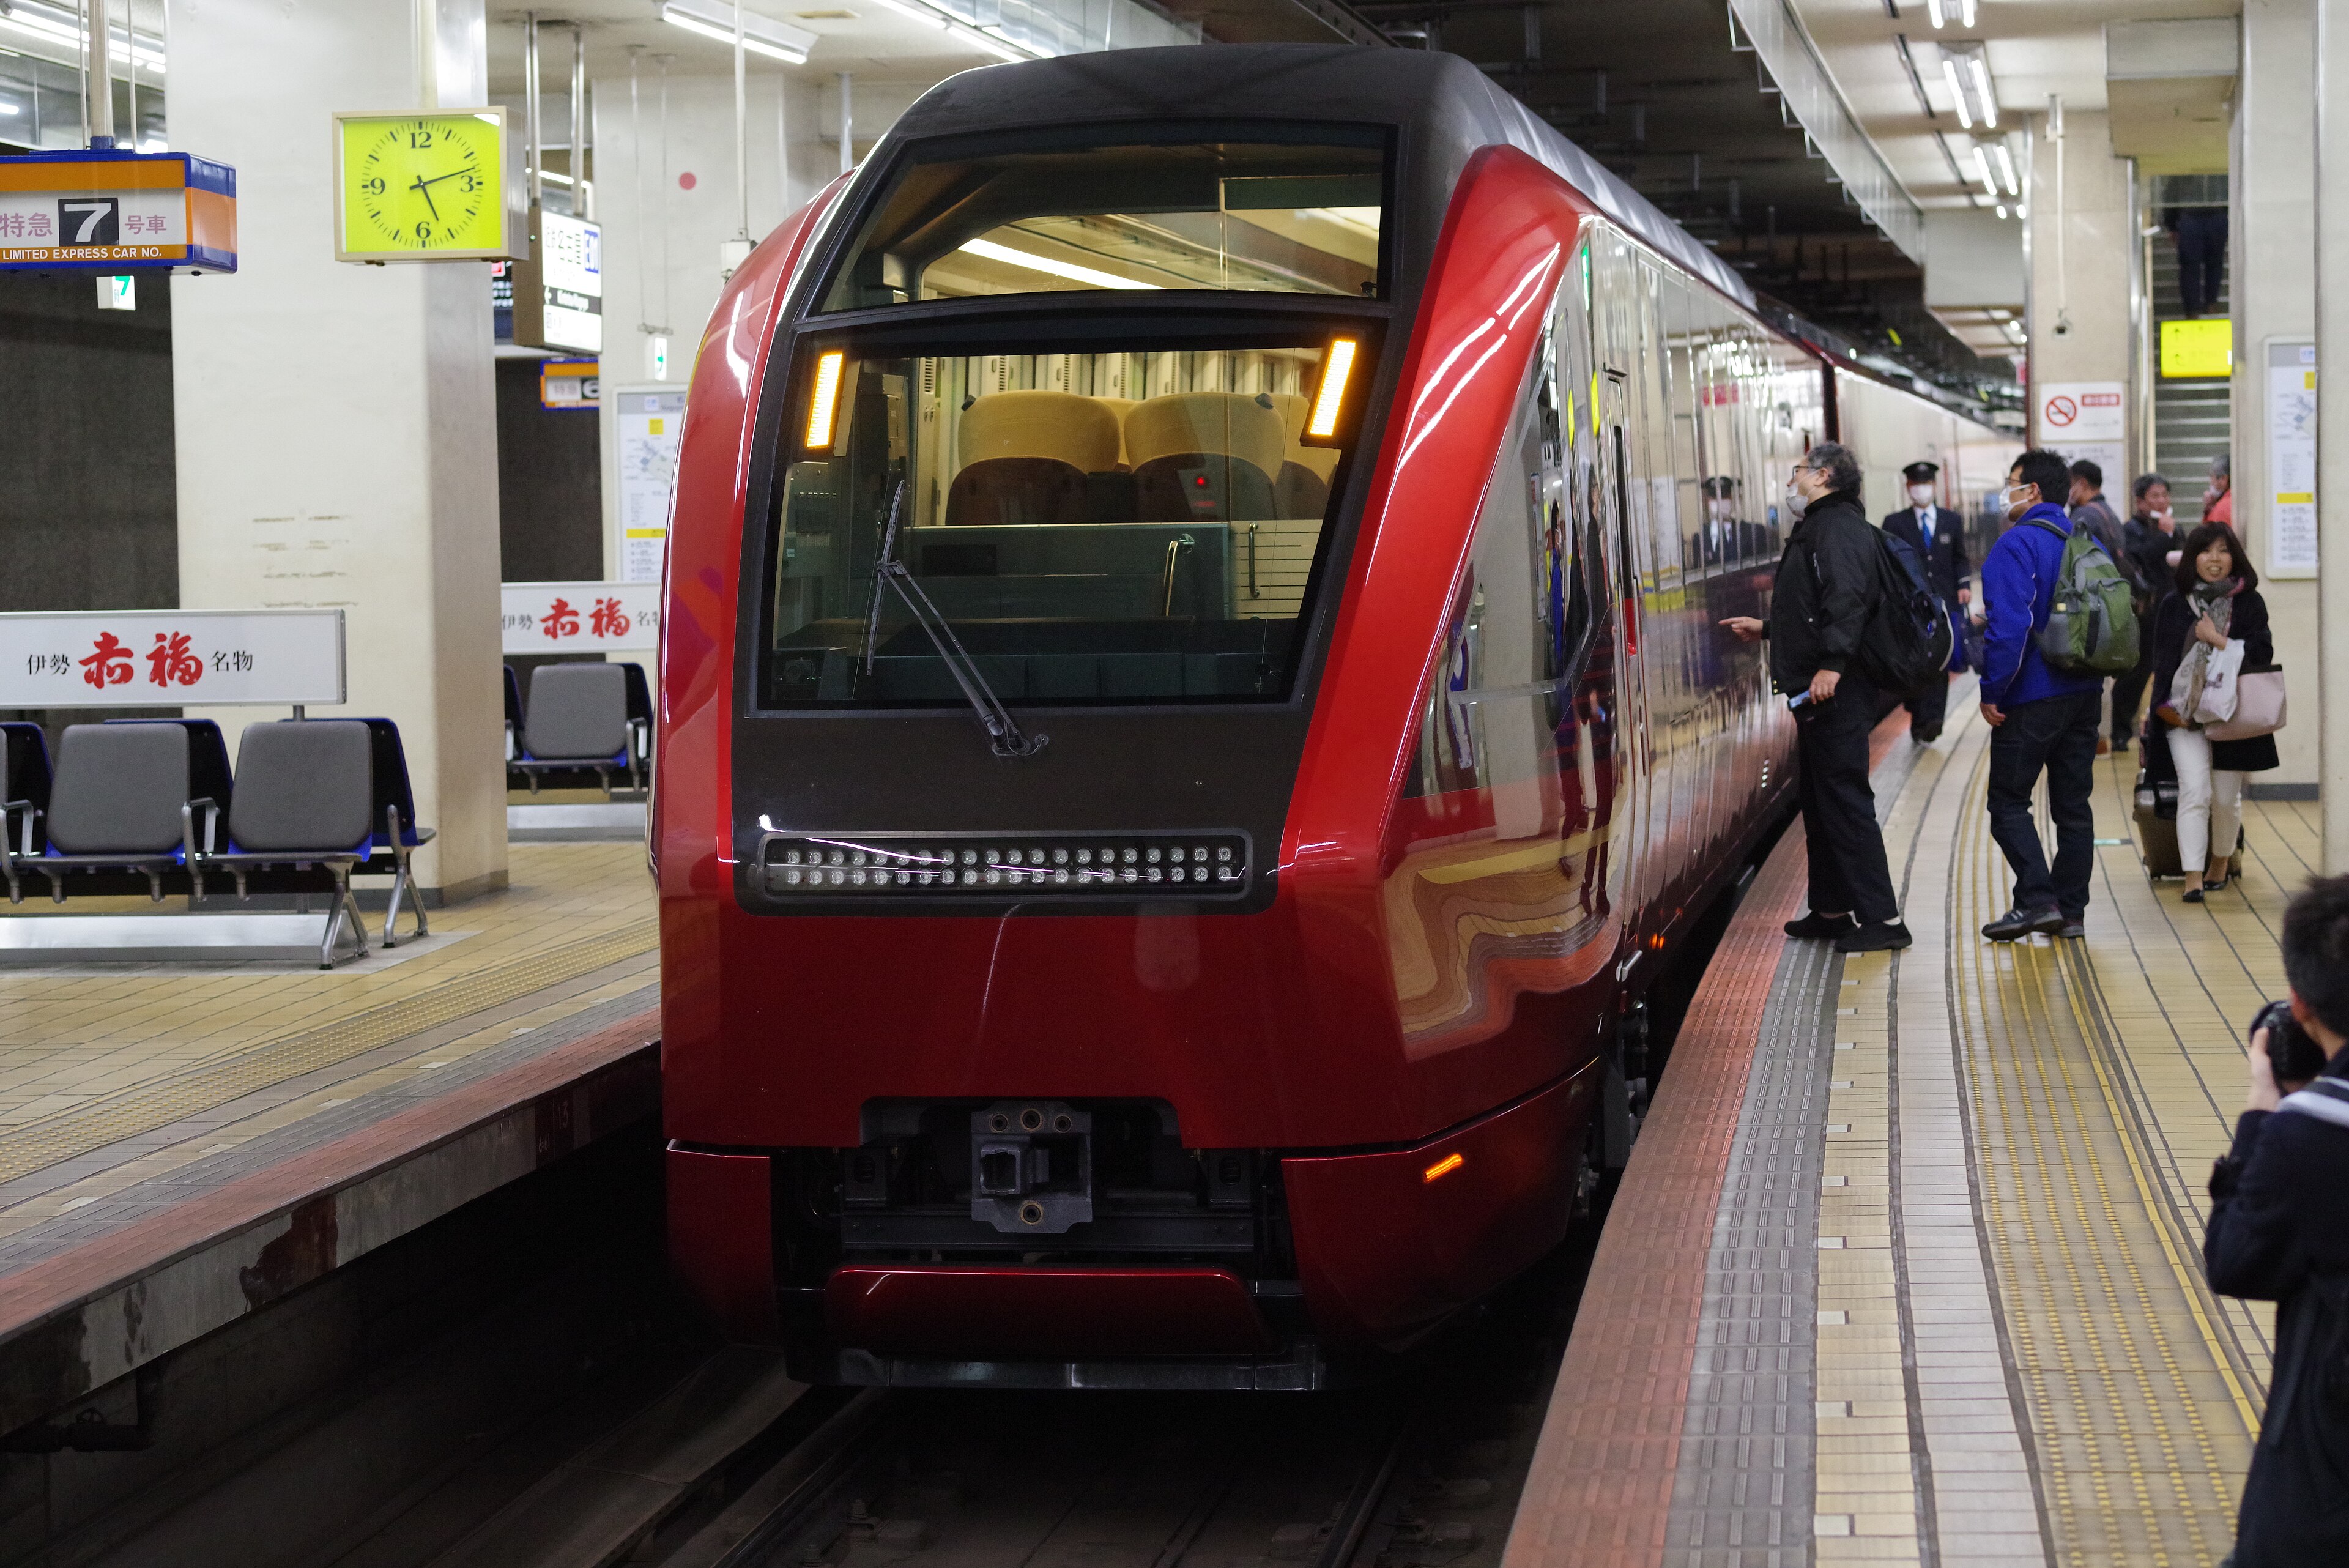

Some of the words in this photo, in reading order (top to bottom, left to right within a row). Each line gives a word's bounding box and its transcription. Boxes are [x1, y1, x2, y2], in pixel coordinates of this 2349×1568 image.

[410, 133, 431, 148] 12
[371, 178, 385, 195] 9
[461, 175, 475, 192] 3
[0, 213, 52, 238] 特急
[64, 203, 112, 242] 7
[125, 215, 166, 234] 号車
[415, 222, 431, 239] 6
[2, 249, 48, 260] LIMITED
[53, 248, 108, 259] EXPRESS
[112, 248, 137, 258] CAR
[141, 247, 162, 258] NO.
[540, 598, 630, 639] 赤福
[27, 654, 70, 675] 伊勢
[78, 631, 203, 689] 赤福
[210, 650, 253, 672] 名物
